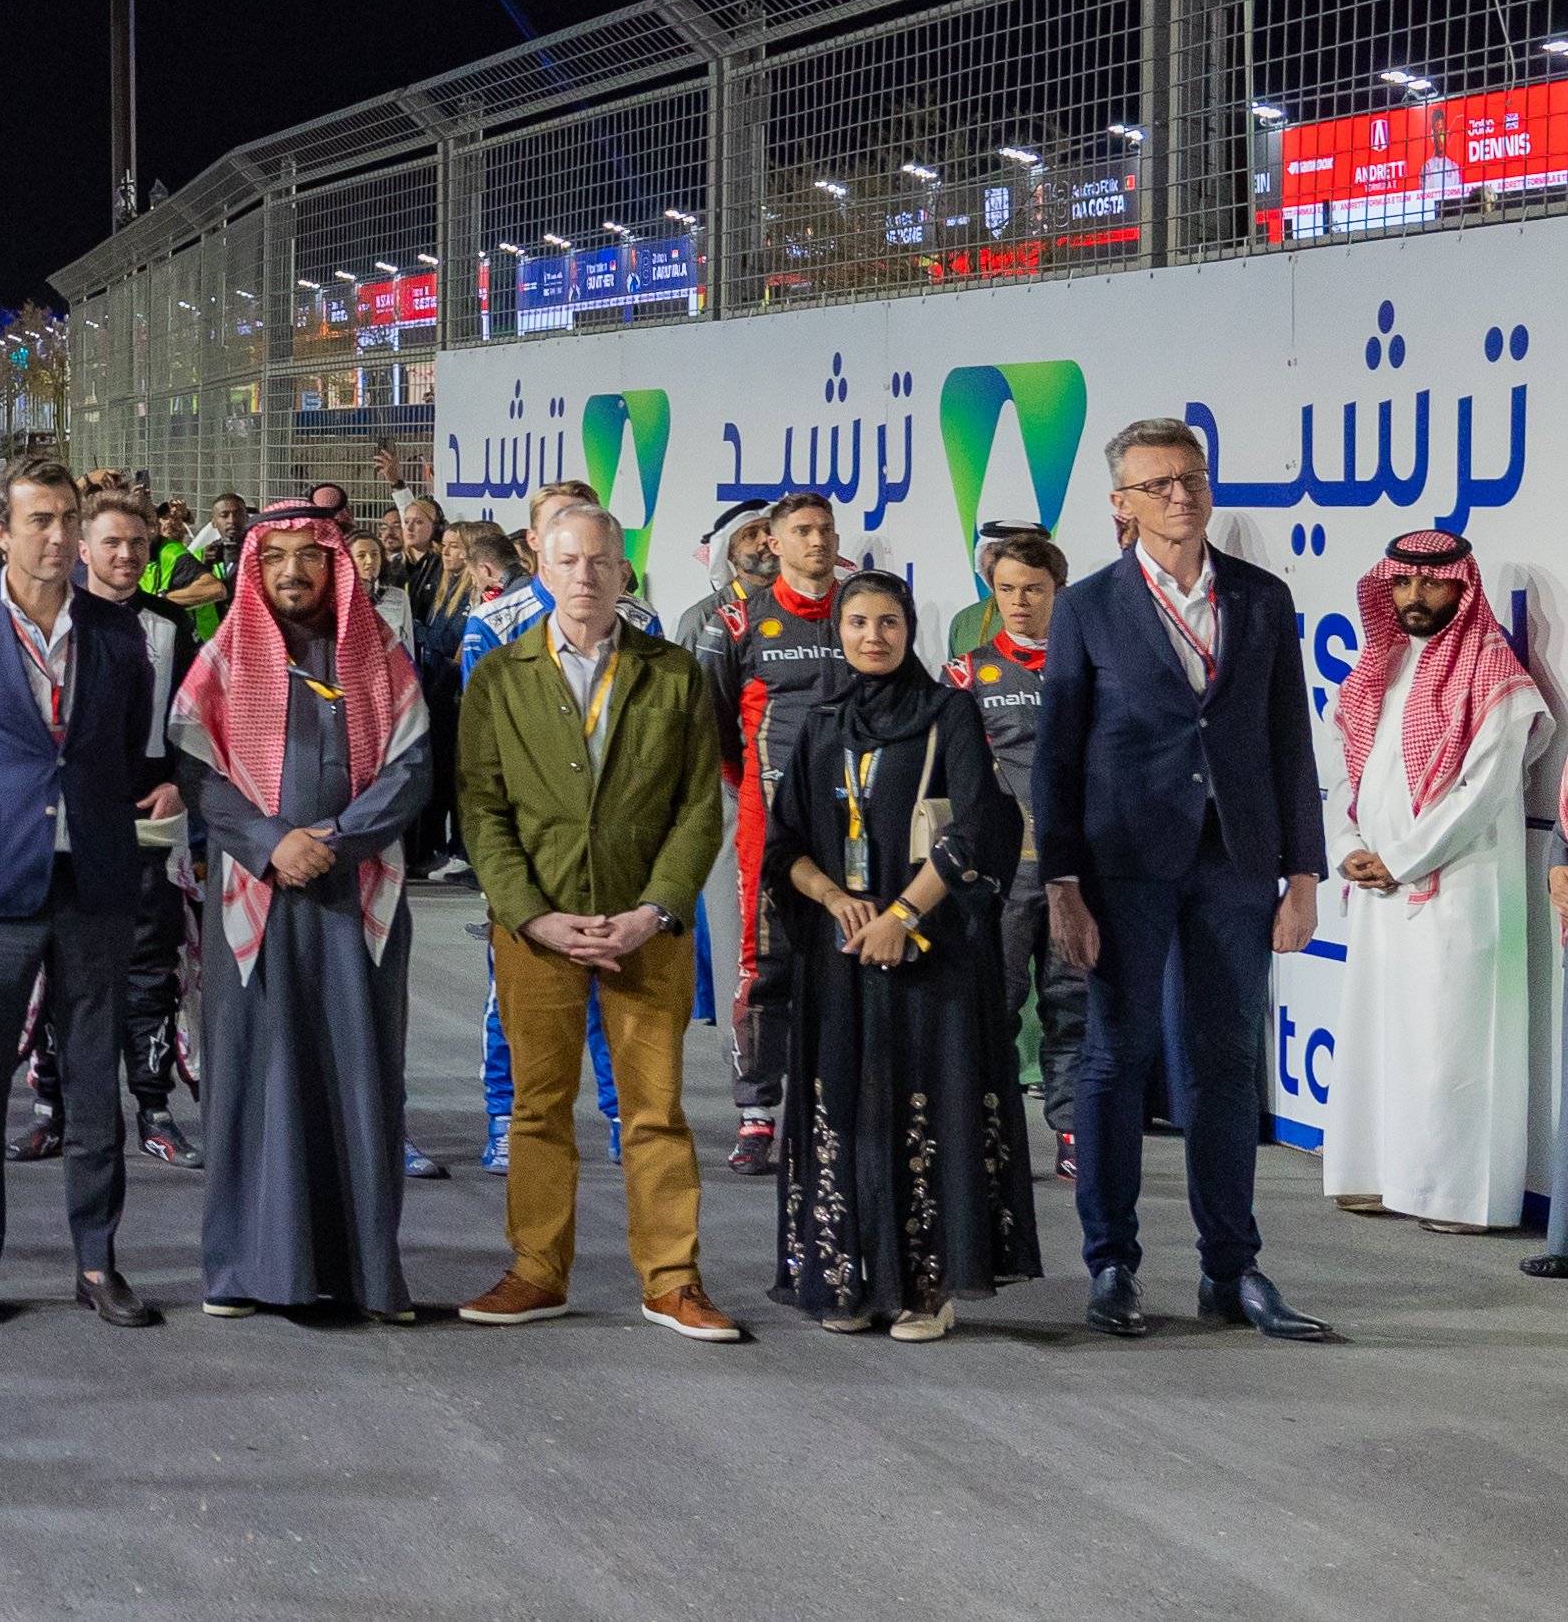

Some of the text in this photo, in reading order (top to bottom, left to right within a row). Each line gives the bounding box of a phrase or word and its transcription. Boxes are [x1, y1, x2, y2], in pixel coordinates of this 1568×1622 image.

[1468, 132, 1531, 163] DENNIS
[1355, 160, 1406, 183] ANDRETT
[983, 691, 1041, 709] mahi
